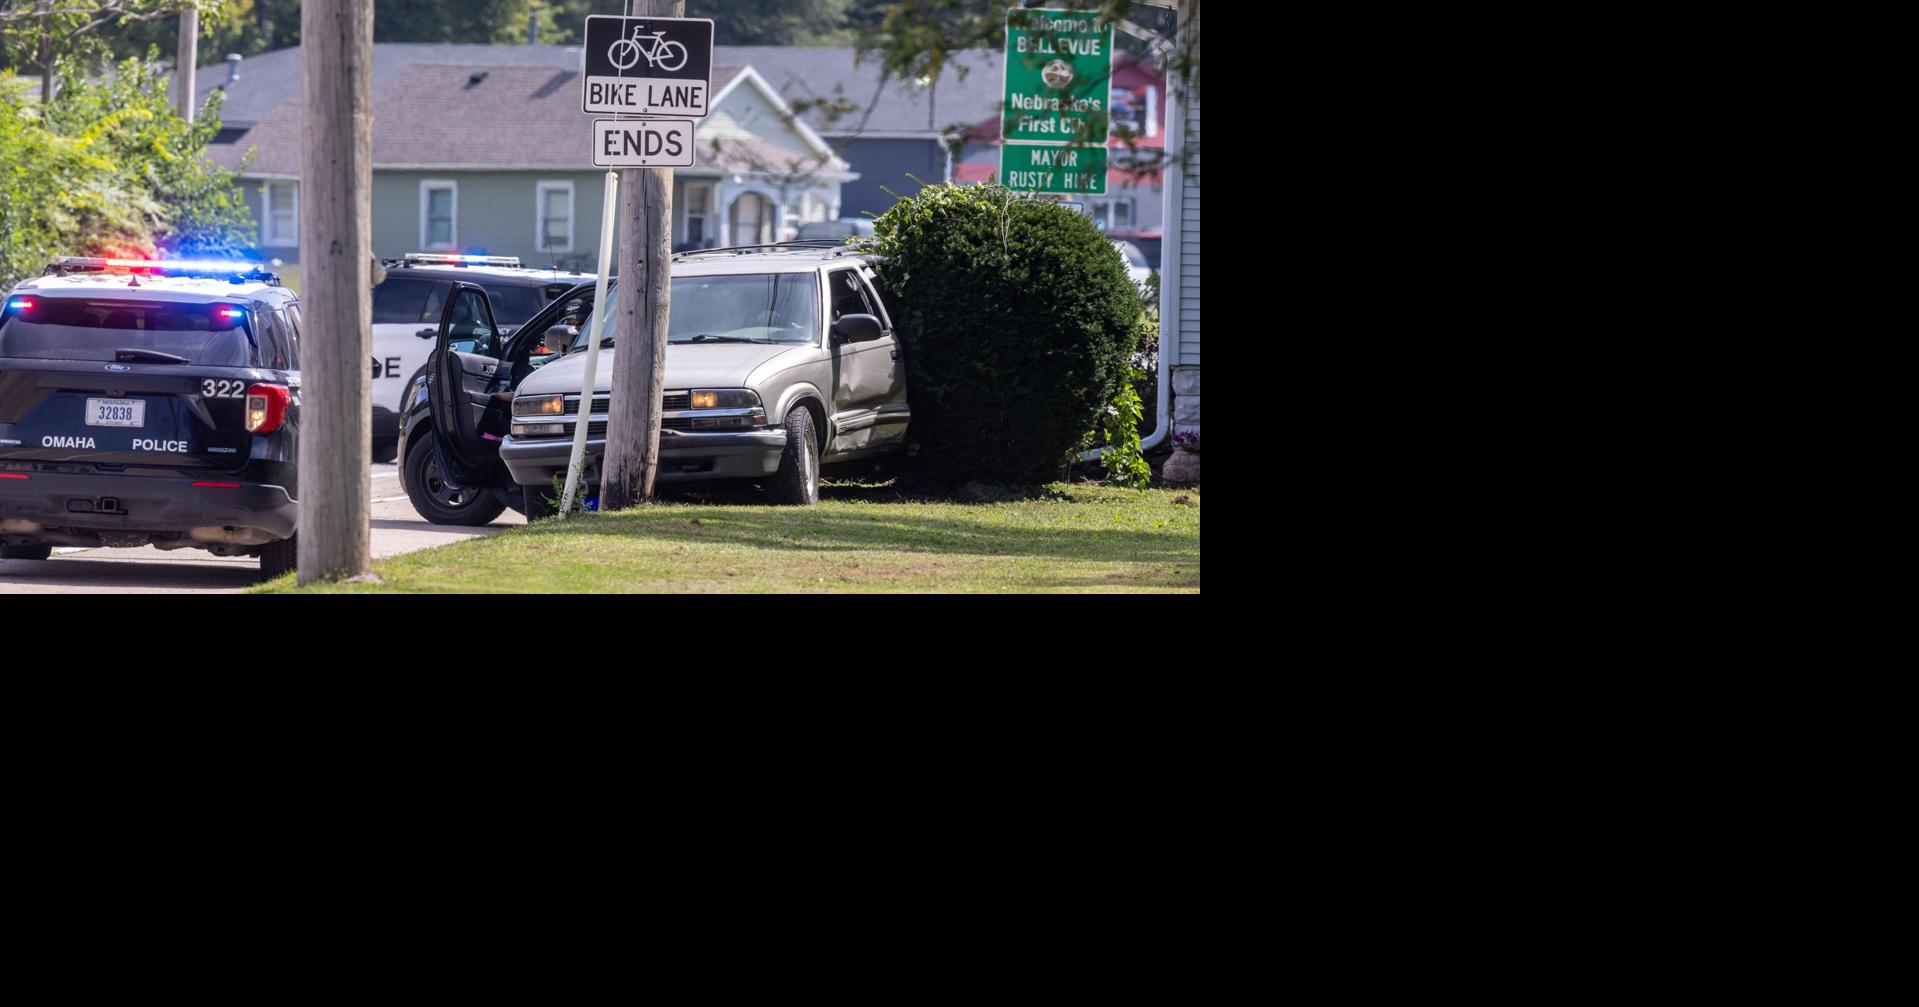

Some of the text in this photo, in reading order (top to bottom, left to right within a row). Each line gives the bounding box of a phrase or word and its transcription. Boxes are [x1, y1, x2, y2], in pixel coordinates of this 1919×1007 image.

[1012, 14, 1088, 33] elcome
[589, 83, 703, 109] BIKE LANE
[1011, 93, 1102, 112] Nebraka's
[1018, 116, 1056, 133] First
[604, 130, 683, 157] ENDS
[1031, 149, 1078, 167] MAYOR
[1009, 171, 1098, 190] RUSTY HIKE
[202, 379, 245, 398] 322
[98, 406, 133, 421] 32838
[41, 436, 188, 453] OMAHA POLICE
